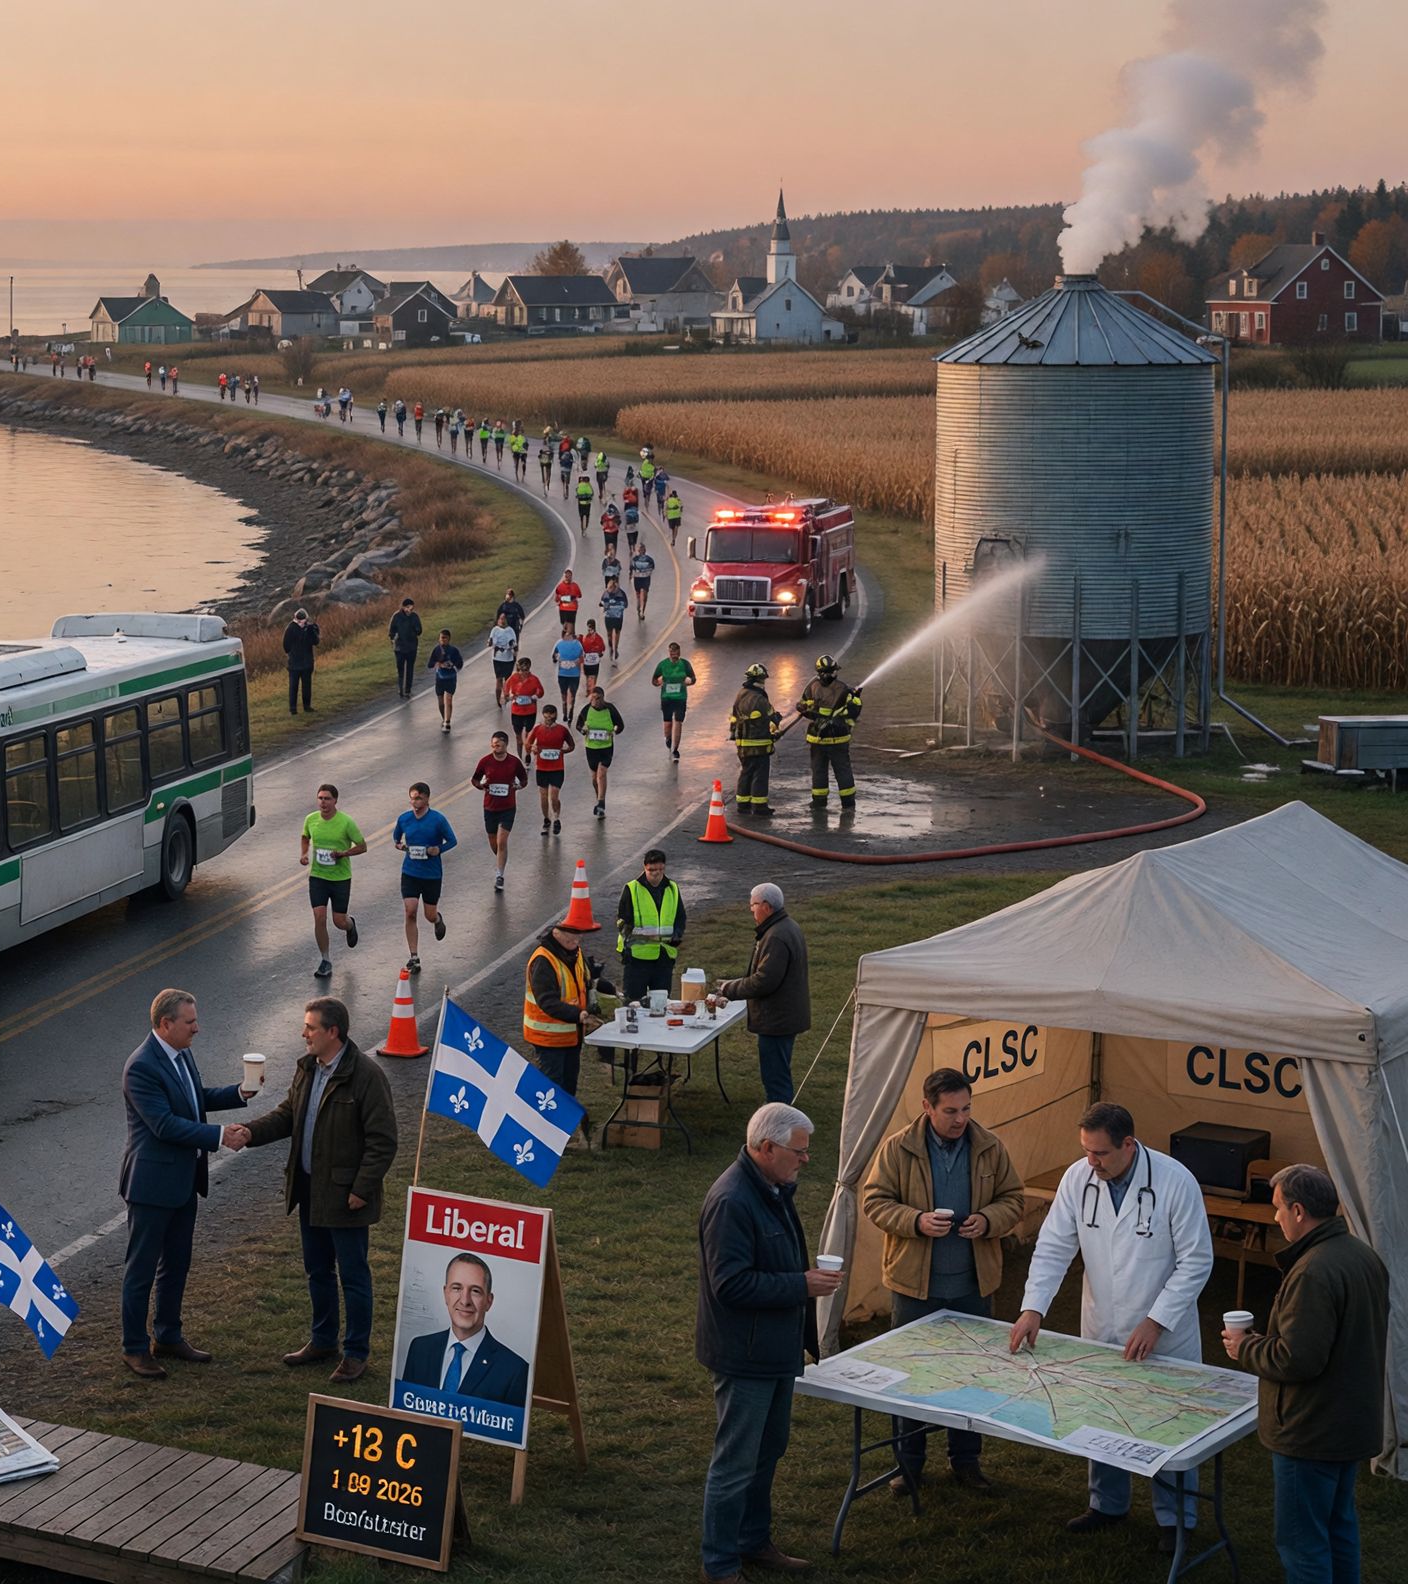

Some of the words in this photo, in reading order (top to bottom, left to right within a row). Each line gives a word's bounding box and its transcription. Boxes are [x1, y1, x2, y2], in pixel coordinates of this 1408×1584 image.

[962, 1025, 1038, 1084] CLSC
[1186, 1045, 1302, 1098] CLSC
[426, 1205, 525, 1249] Liberal
[396, 1433, 417, 1470] C
[376, 1478, 423, 1507] 2026
